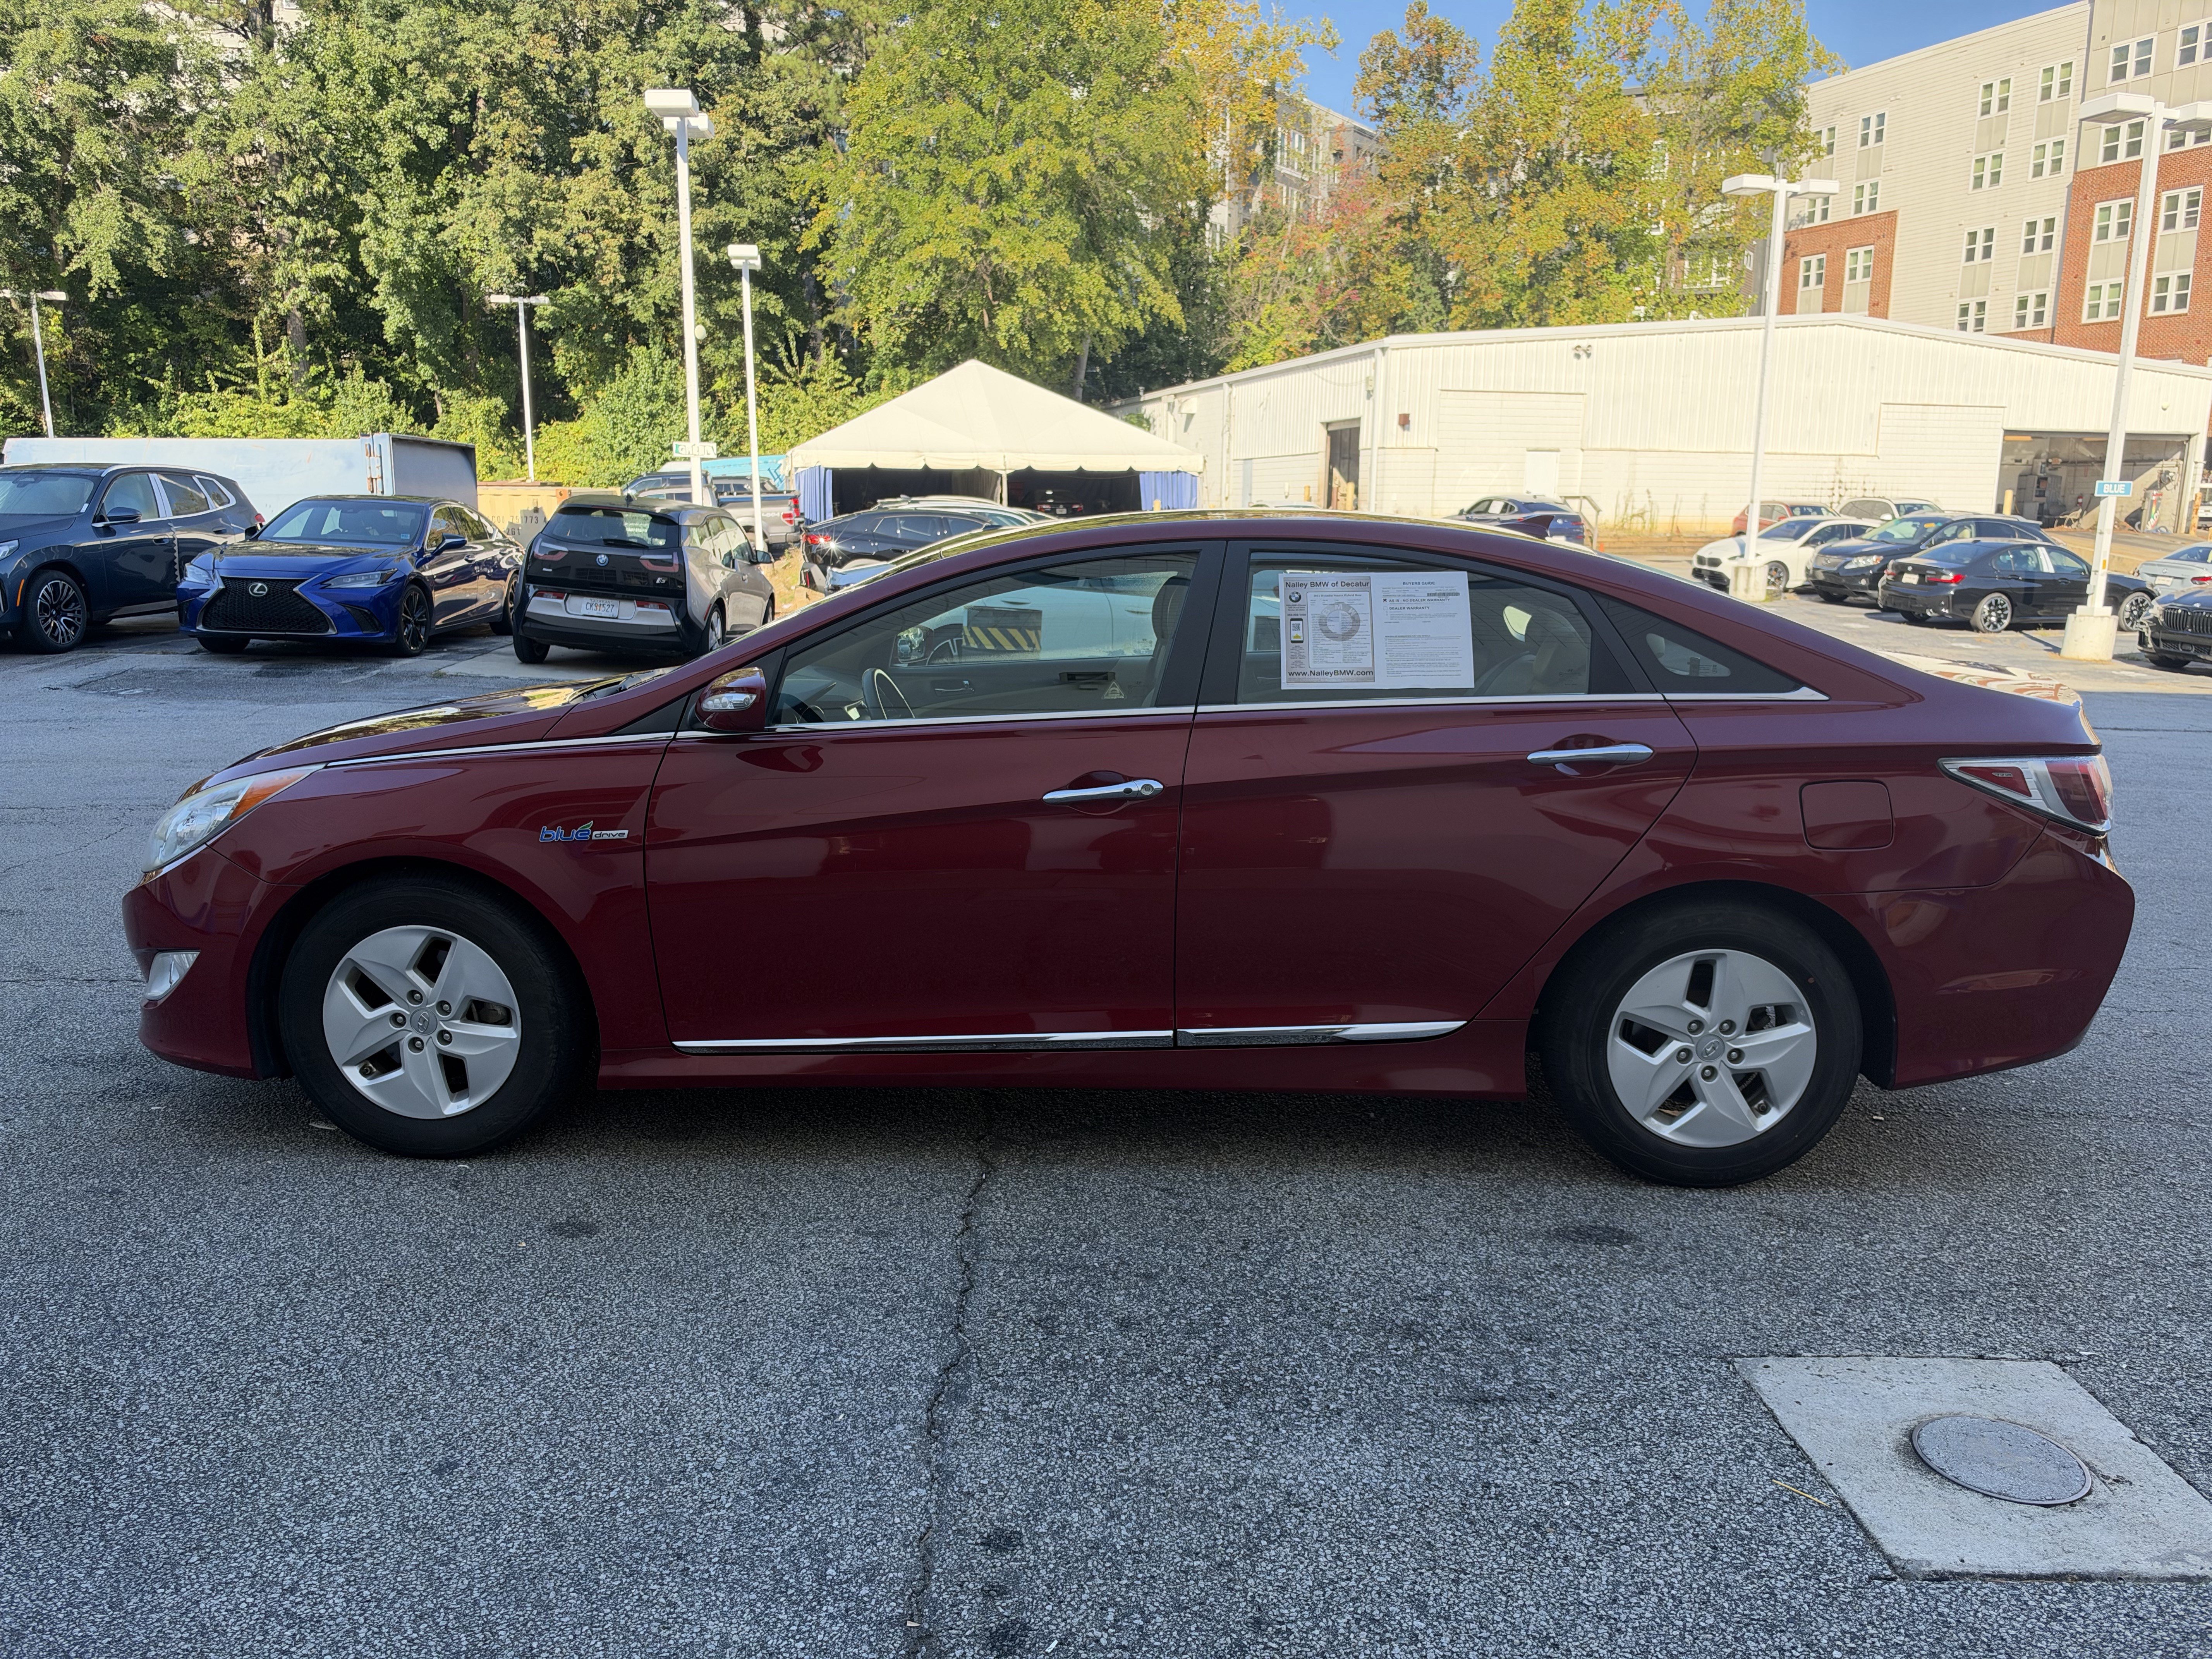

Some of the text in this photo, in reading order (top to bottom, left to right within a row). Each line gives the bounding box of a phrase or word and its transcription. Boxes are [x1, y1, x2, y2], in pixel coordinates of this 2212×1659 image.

[2103, 484, 2126, 493] BLUE
[510, 515, 538, 524] 751773
[539, 825, 592, 842] blue
